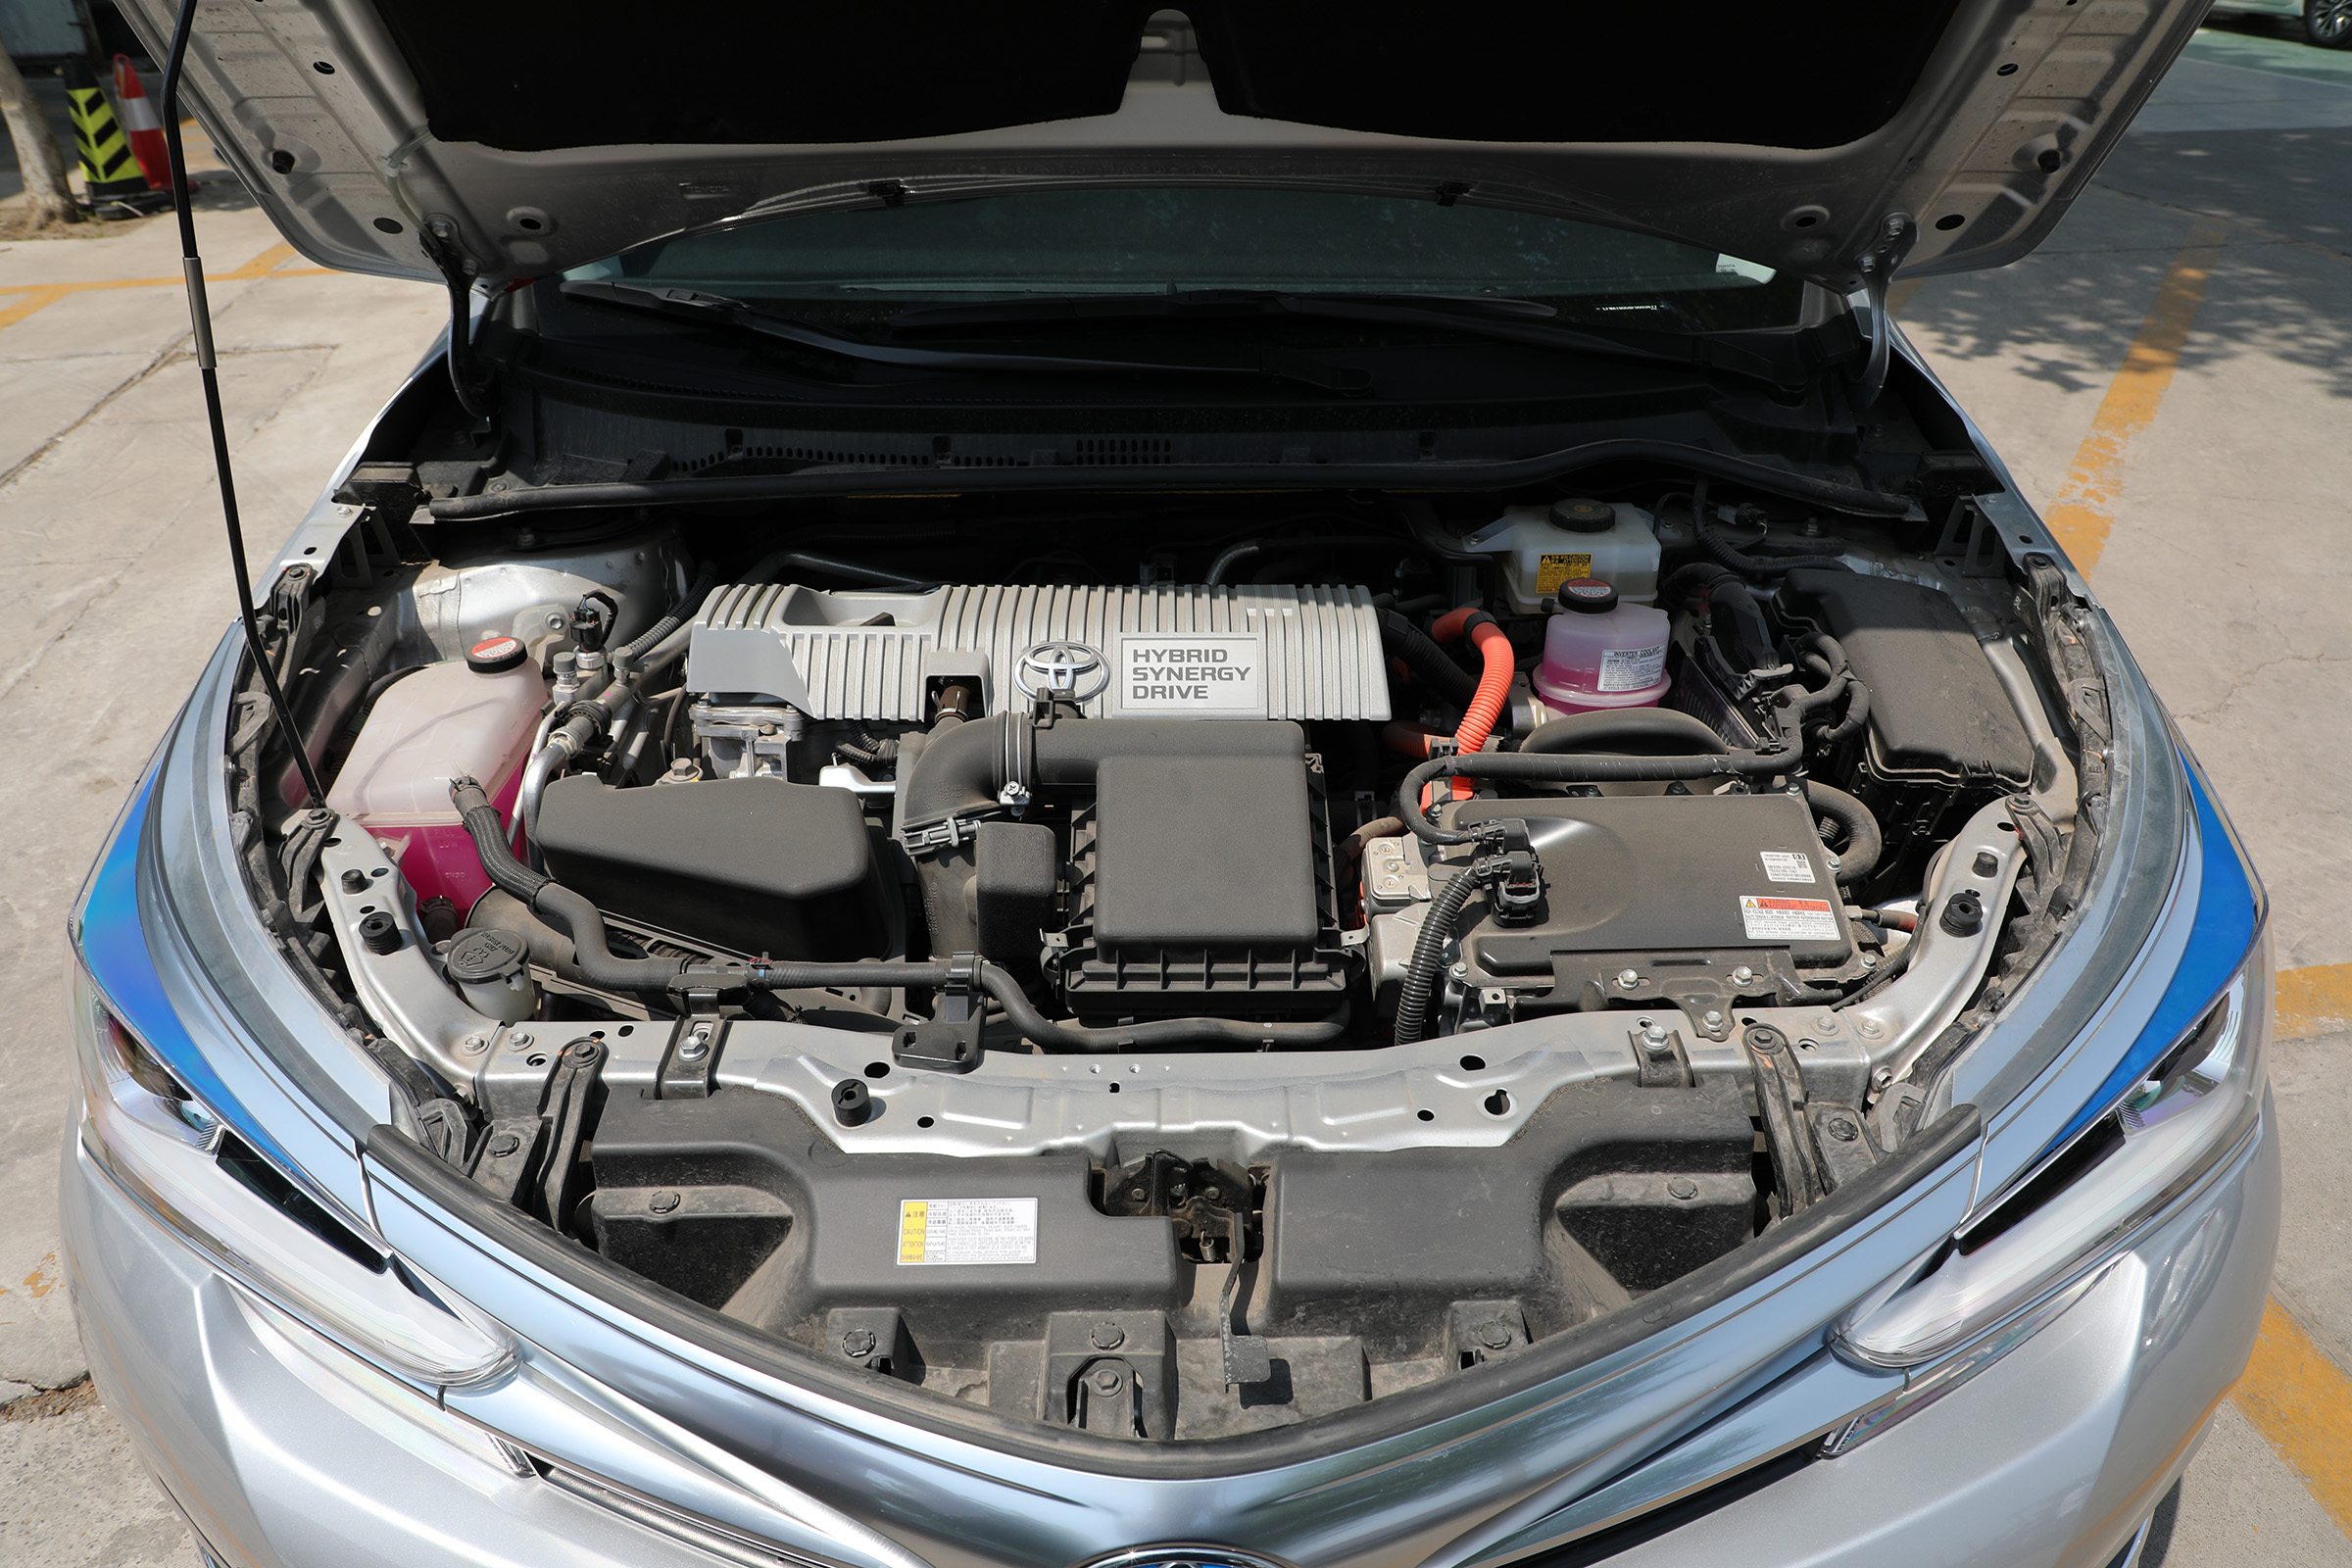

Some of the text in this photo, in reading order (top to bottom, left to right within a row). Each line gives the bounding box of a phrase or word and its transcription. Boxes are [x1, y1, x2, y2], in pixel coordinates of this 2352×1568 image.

[1132, 649, 1228, 662] HYBRID
[1132, 666, 1251, 681] SYNERGY
[1132, 685, 1209, 700] DRIVE
